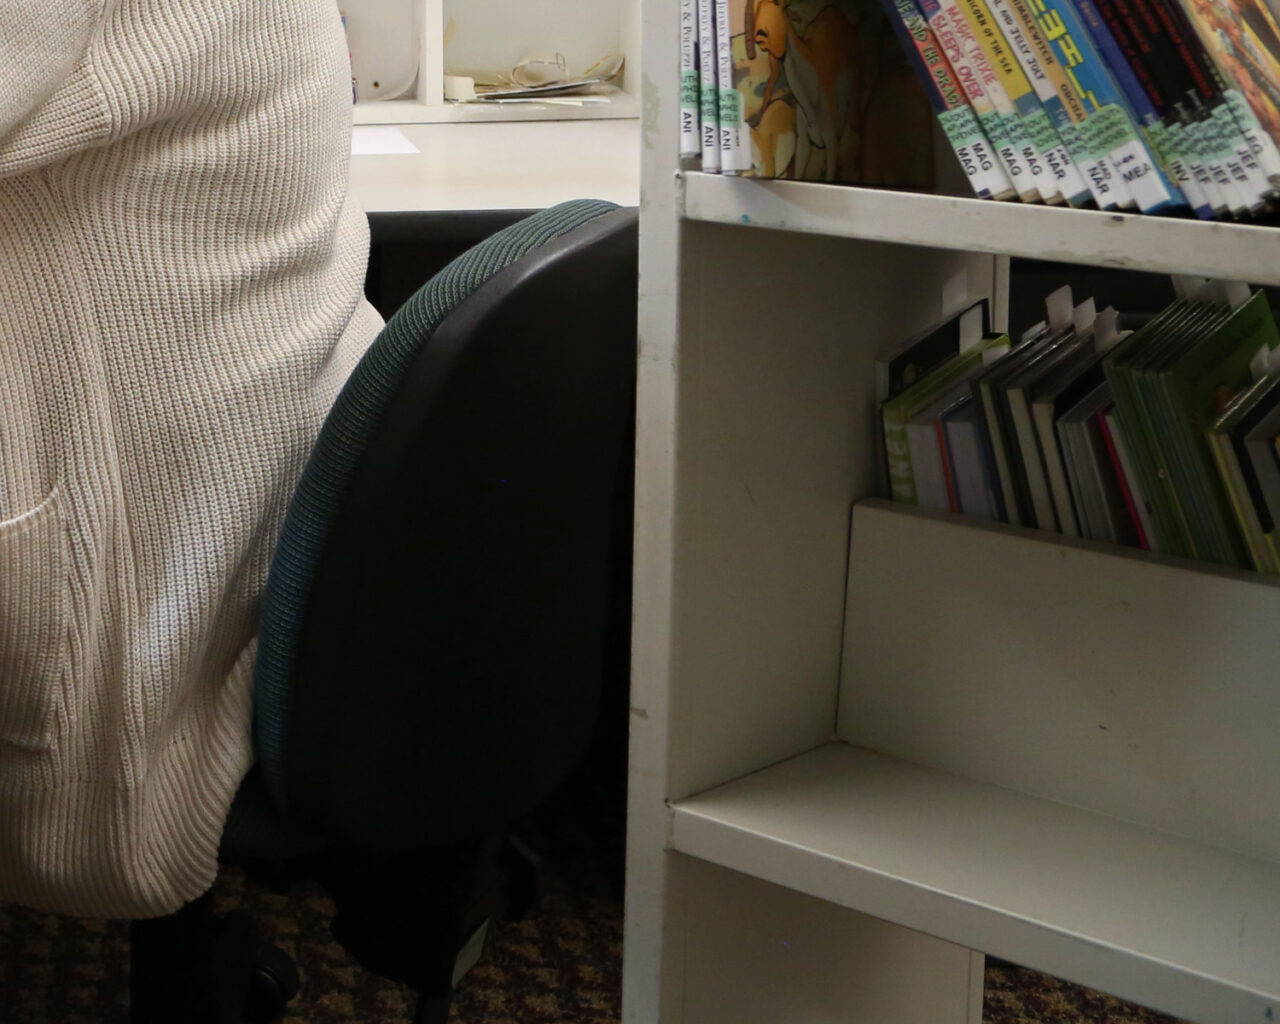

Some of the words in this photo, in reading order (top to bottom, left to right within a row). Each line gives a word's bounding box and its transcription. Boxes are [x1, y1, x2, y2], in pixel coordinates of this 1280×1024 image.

[683, 12, 692, 21] &
[717, 2, 728, 38] JEFFREY
[702, 36, 712, 44] &
[720, 42, 729, 51] &
[945, 4, 976, 46] MAGIC
[968, 45, 998, 86] TRIXIE
[983, 27, 994, 39] OF
[989, 39, 1004, 56] THE
[999, 56, 1014, 75] SEA
[1000, 8, 1014, 26] AND
[1010, 27, 1031, 56] JELLY
[1026, 56, 1046, 83] JOLT
[905, 13, 928, 43] AND
[922, 44, 941, 67] THE
[933, 66, 964, 110] DRAG
[930, 13, 966, 64] SLEEPS
[956, 63, 985, 101] OVER
[682, 112, 693, 133] ANI
[703, 126, 714, 147] ANI
[722, 129, 731, 150] ANI
[956, 147, 979, 176] MAG
[970, 141, 994, 172] MAG
[1000, 147, 1023, 177] MAG
[1020, 146, 1044, 177] MAG
[1044, 151, 1067, 181] NAR
[1236, 146, 1258, 172] JEF
[1087, 165, 1110, 195] NAR
[1122, 160, 1152, 184] MEA
[1170, 159, 1190, 184] INV
[1190, 162, 1211, 187] JEF
[1208, 161, 1230, 188] JEF
[1227, 158, 1248, 185] JEF
